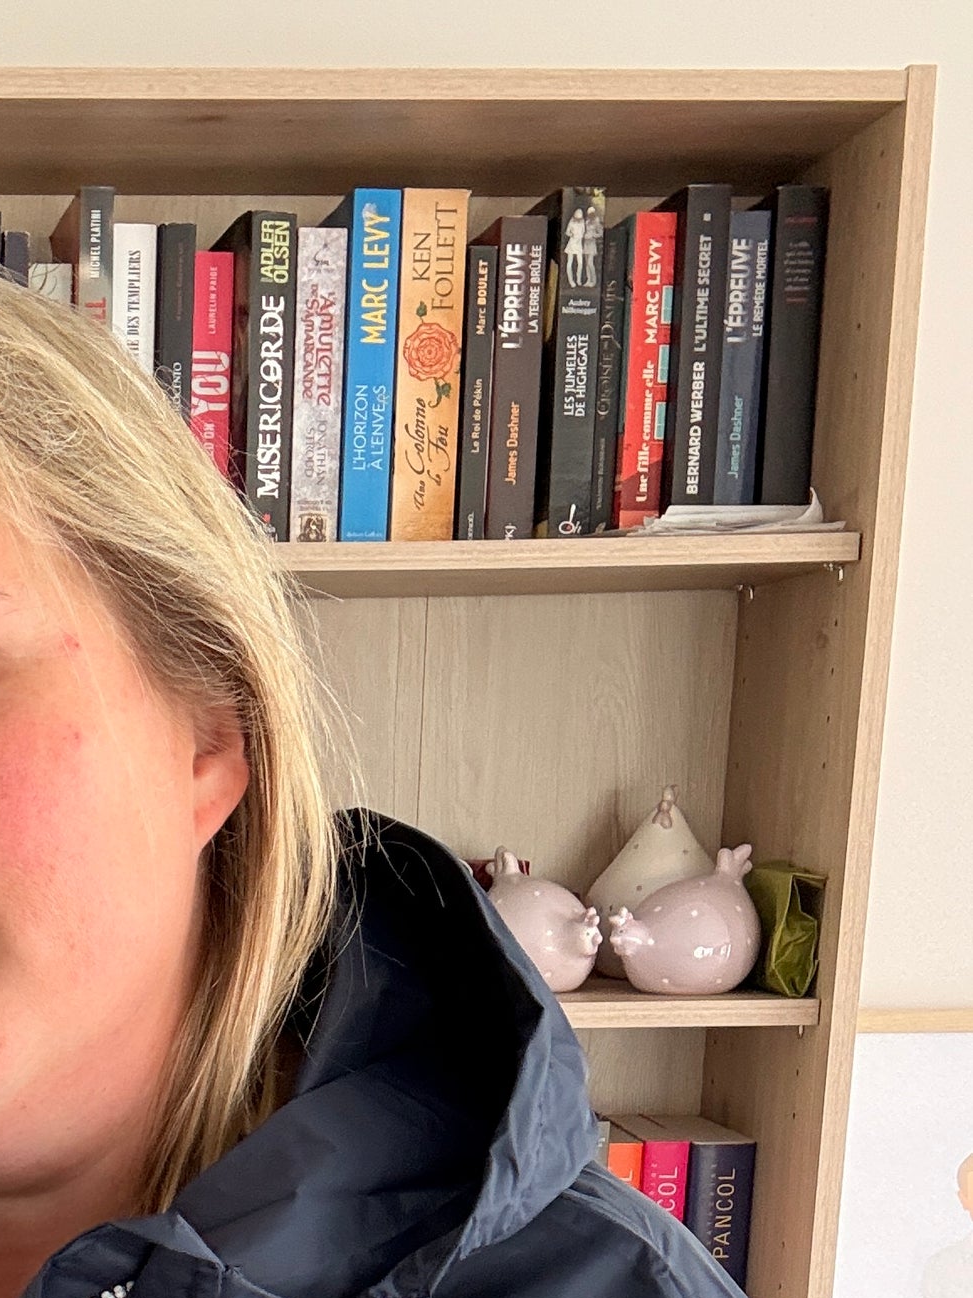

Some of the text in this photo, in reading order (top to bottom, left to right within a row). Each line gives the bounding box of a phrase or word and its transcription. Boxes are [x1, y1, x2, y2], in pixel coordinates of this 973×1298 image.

[90, 209, 101, 278] MICHEL PLATINI
[127, 250, 141, 313] TEMPLIERS
[260, 220, 275, 275] ADLER
[273, 220, 290, 284] OLSEN
[360, 210, 391, 344] MARC LEVY
[412, 232, 431, 282] KEN
[431, 202, 458, 311] FOLLETT
[126, 316, 140, 335] DES
[208, 266, 218, 334] LAURELIN PAIGE
[476, 260, 488, 335] Marc BOULET
[498, 243, 527, 349] L'ÉPREUVE
[528, 245, 542, 334] LA TERRE BRÛLÉE
[644, 239, 662, 344] MARC LEVY
[694, 235, 712, 352] L'ULTIME SECRET
[724, 238, 753, 343] L'ÉPREUVE
[752, 241, 767, 336] LE REMÈDE MORTEL
[191, 350, 230, 416] YOU
[256, 296, 285, 498] MISERICORDE
[471, 379, 483, 453] Le Roi de Pékin
[563, 334, 577, 417] LES JUMELLES
[575, 334, 589, 417] DE HIGHGATE
[352, 385, 368, 471] L'HORIZON
[367, 385, 390, 471] À L'ENVERS
[404, 397, 427, 510] Une Colonne
[427, 425, 451, 486] de Feu
[505, 401, 520, 485] James Dashner
[636, 360, 655, 501] Une fille comme elle
[686, 361, 705, 494] BERNARD WERBER
[728, 395, 744, 479] James Dashner
[713, 1168, 736, 1258] PANCOL
